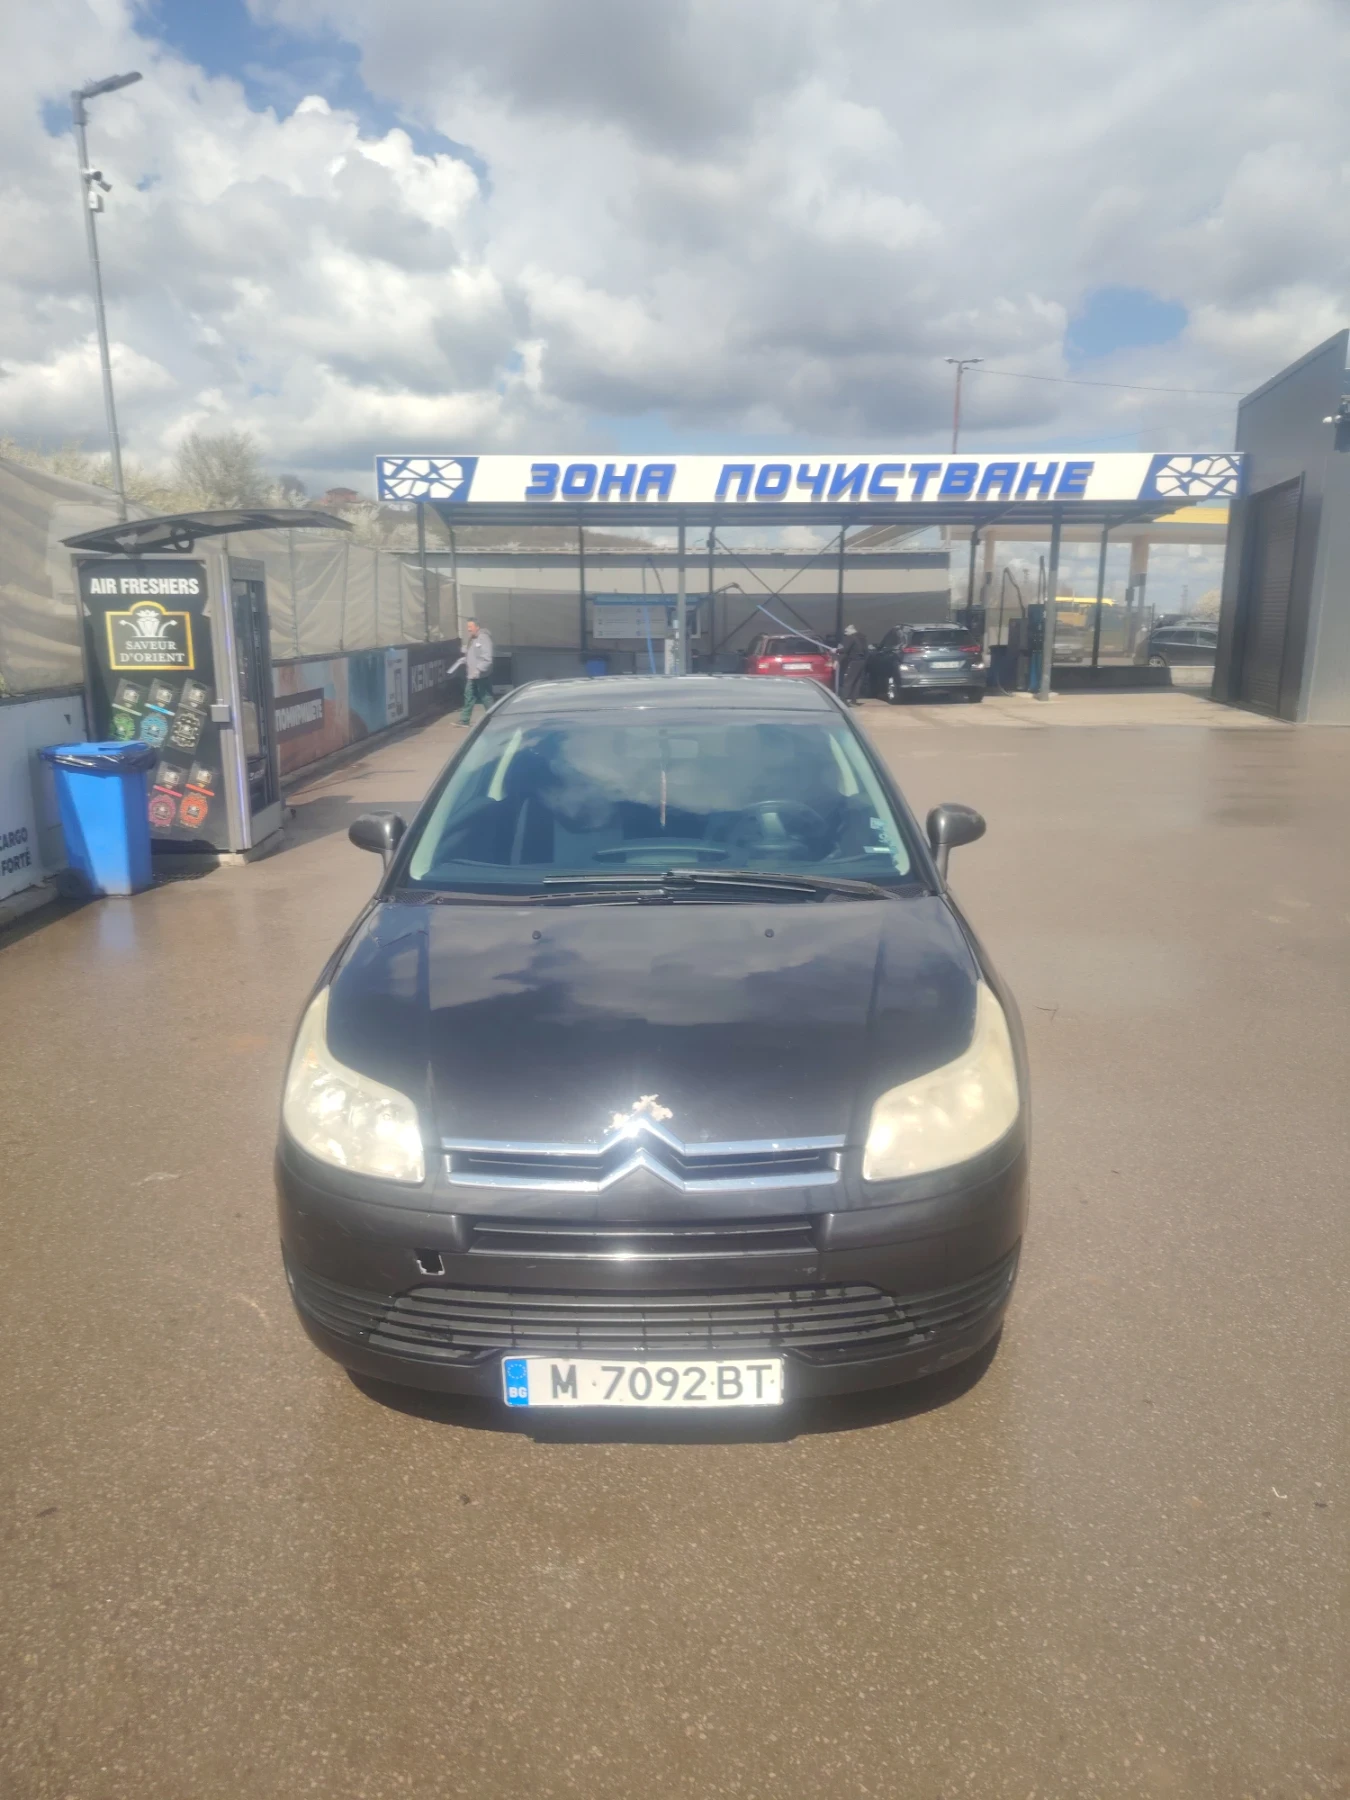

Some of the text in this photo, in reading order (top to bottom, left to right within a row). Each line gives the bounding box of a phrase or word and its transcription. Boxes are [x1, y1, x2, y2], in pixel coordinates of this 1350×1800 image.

[525, 462, 1095, 500] ЗОНА ПОЧИСТВАНЕ
[90, 578, 200, 595] AIR FRESHERS
[125, 641, 177, 650] SAVEUR
[119, 652, 185, 663] D'ORIENT
[550, 1364, 773, 1401] M 7092 BT
[508, 1386, 528, 1399] BG
